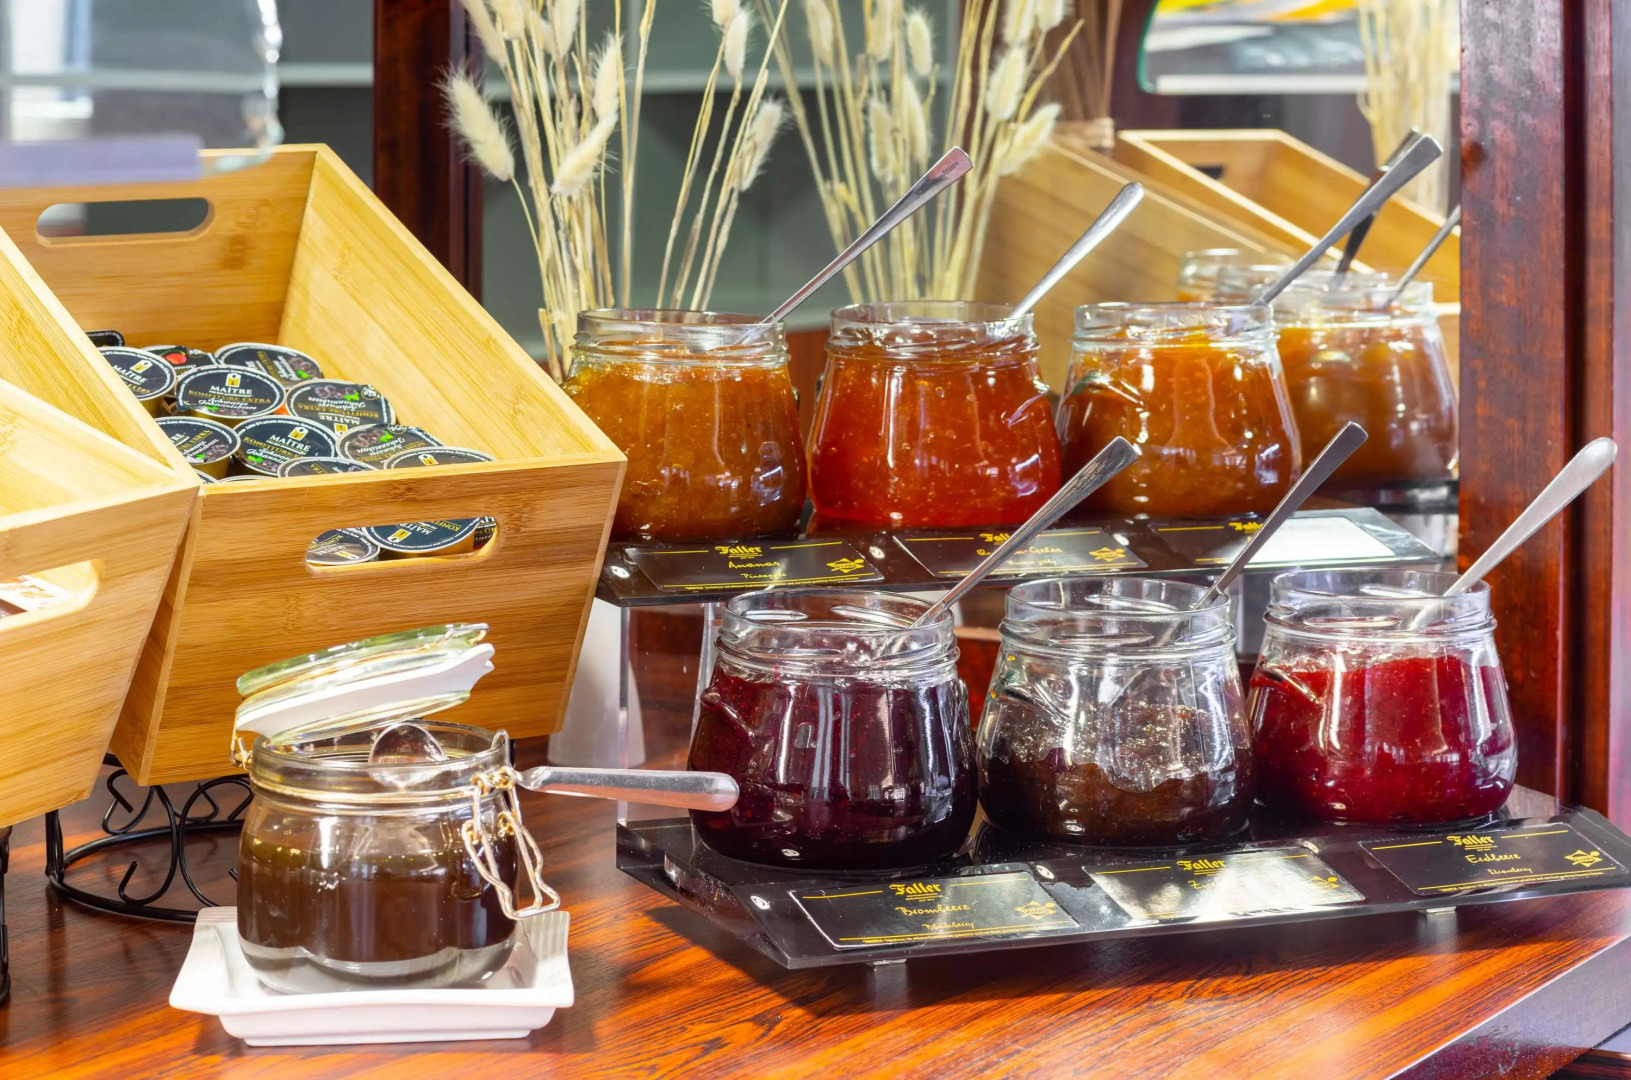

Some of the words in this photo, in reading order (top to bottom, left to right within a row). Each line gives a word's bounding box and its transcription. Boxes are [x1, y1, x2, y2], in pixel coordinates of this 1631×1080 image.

[210, 385, 254, 396] MAÎTRE
[269, 434, 312, 452] MAÎTRE
[979, 533, 1010, 543] Fall
[714, 545, 762, 555] Faller
[728, 561, 781, 569] Ananas
[1446, 835, 1495, 846] Faller
[1464, 853, 1521, 864] Erdbeere
[1176, 859, 1227, 871] Faller
[889, 883, 942, 896] Faller
[895, 903, 971, 916] Brombeere
